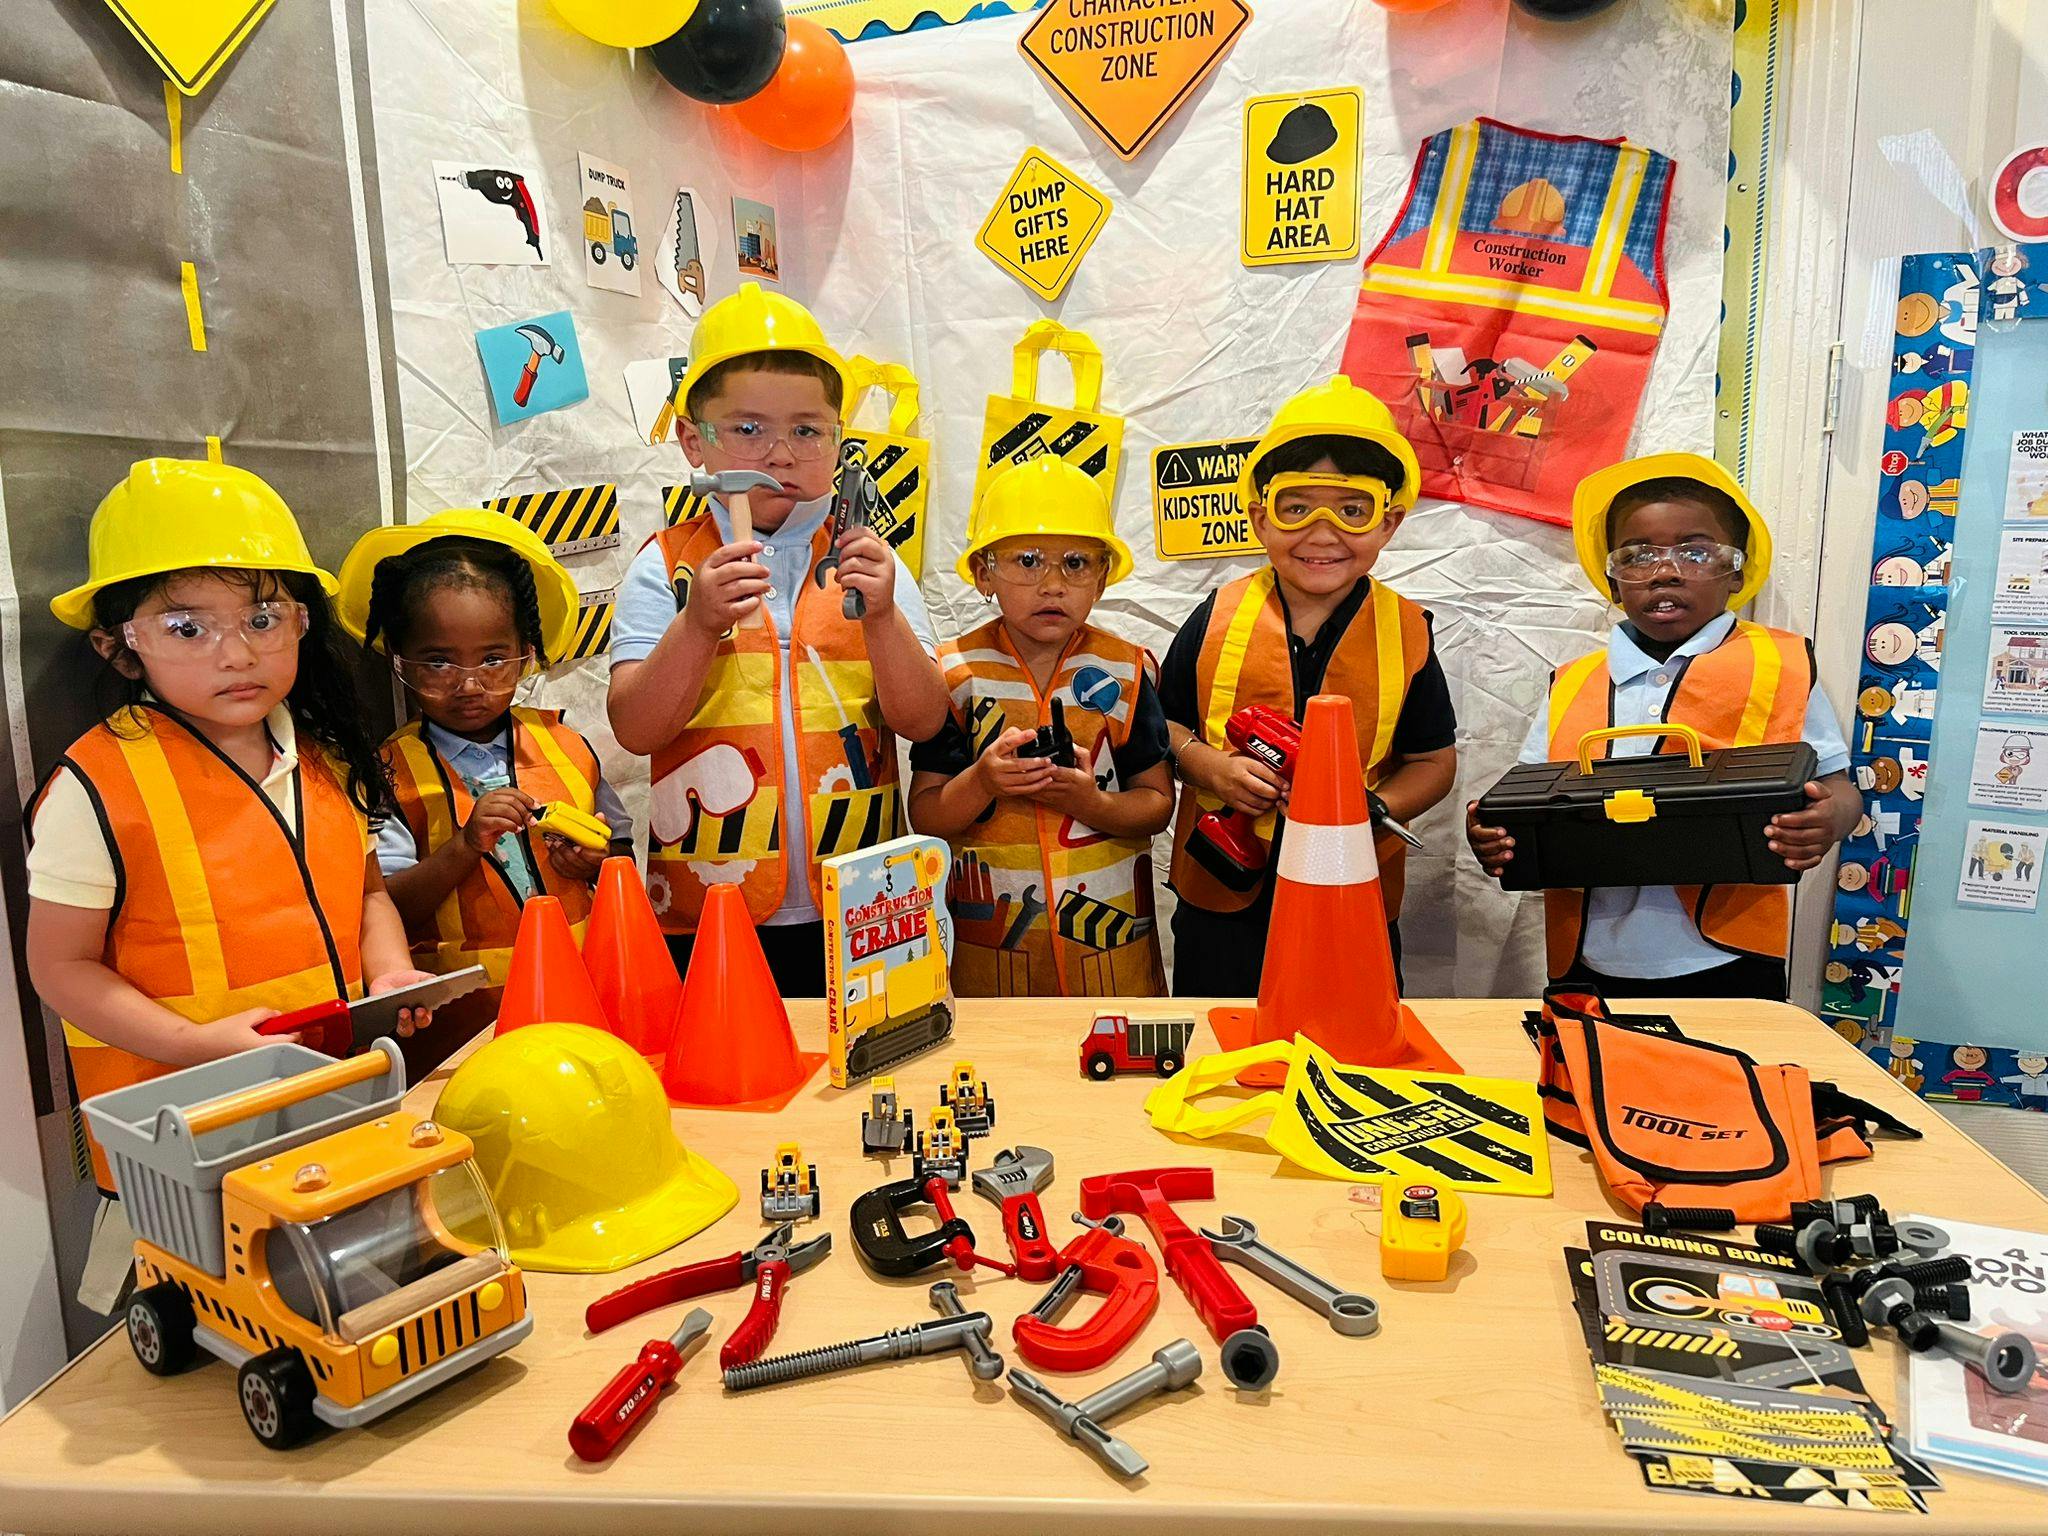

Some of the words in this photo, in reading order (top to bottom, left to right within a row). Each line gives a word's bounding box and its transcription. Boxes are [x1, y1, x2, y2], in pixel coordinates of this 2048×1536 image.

[1050, 10, 1214, 54] CONSTRUCTION
[1101, 51, 1158, 82] ZONE
[588, 167, 605, 183] DUMP
[606, 173, 626, 191] TRUCK
[1266, 167, 1335, 196] HARD
[1010, 181, 1066, 214] DUMP
[1275, 196, 1325, 222] HAT
[1014, 208, 1069, 239] GIFTS
[1266, 223, 1331, 251] AREA
[1020, 234, 1070, 265] HERE
[1473, 239, 1567, 265] Construction
[1488, 256, 1545, 278] Worker
[1197, 452, 1251, 480] WARN
[1163, 491, 1244, 521] KIDSTRUC
[1201, 519, 1248, 546] ZONE
[1250, 738, 1283, 762] TOOL
[844, 885, 934, 929] CONSTRUCTION
[850, 909, 928, 958] CRANE
[828, 986, 839, 1034] CRANE
[1363, 1116, 1477, 1153] CONSTRUCTON
[1621, 1105, 1718, 1140] TOOL
[1699, 1129, 1748, 1141] SET
[1599, 1228, 1721, 1258] COLORING
[1725, 1246, 1797, 1270] BOOK
[1699, 1401, 1748, 1421] UNDER
[1722, 1434, 1773, 1457] UNDER
